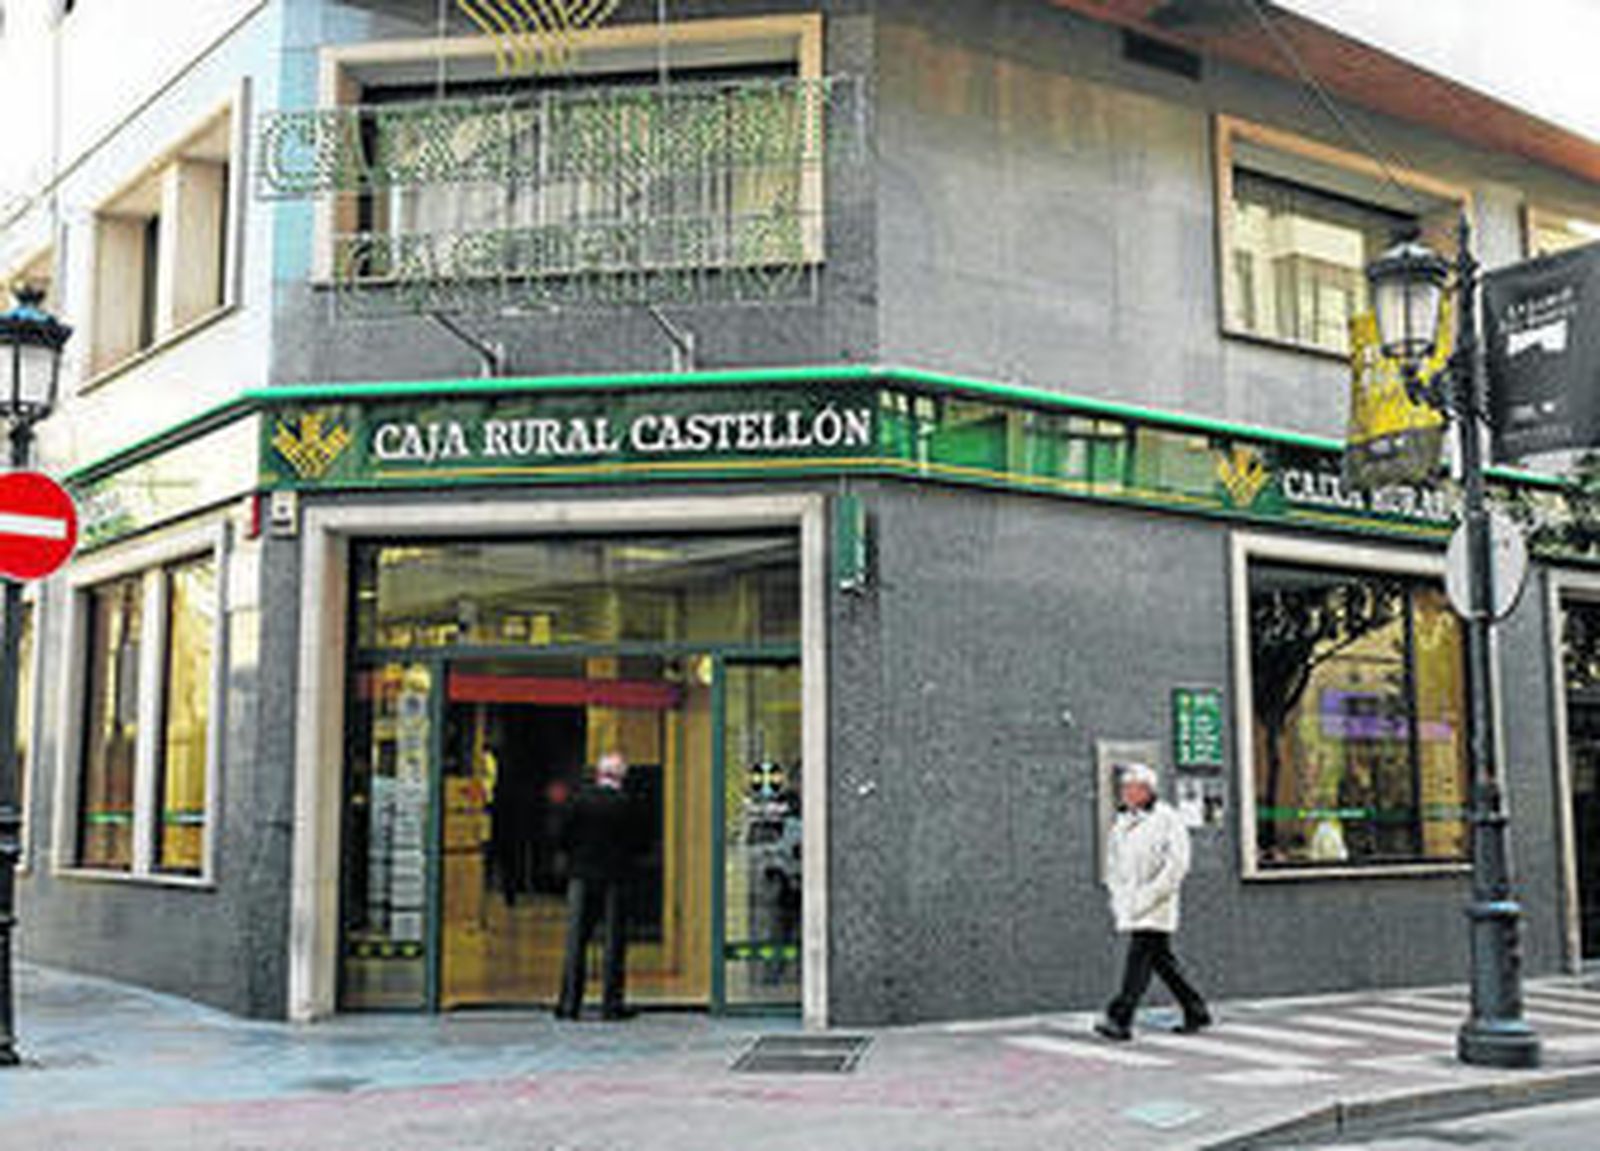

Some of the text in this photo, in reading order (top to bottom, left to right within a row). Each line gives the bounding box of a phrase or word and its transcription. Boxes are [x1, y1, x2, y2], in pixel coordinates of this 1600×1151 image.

[373, 401, 871, 463] CAJA RURAL CASTELLÓN
